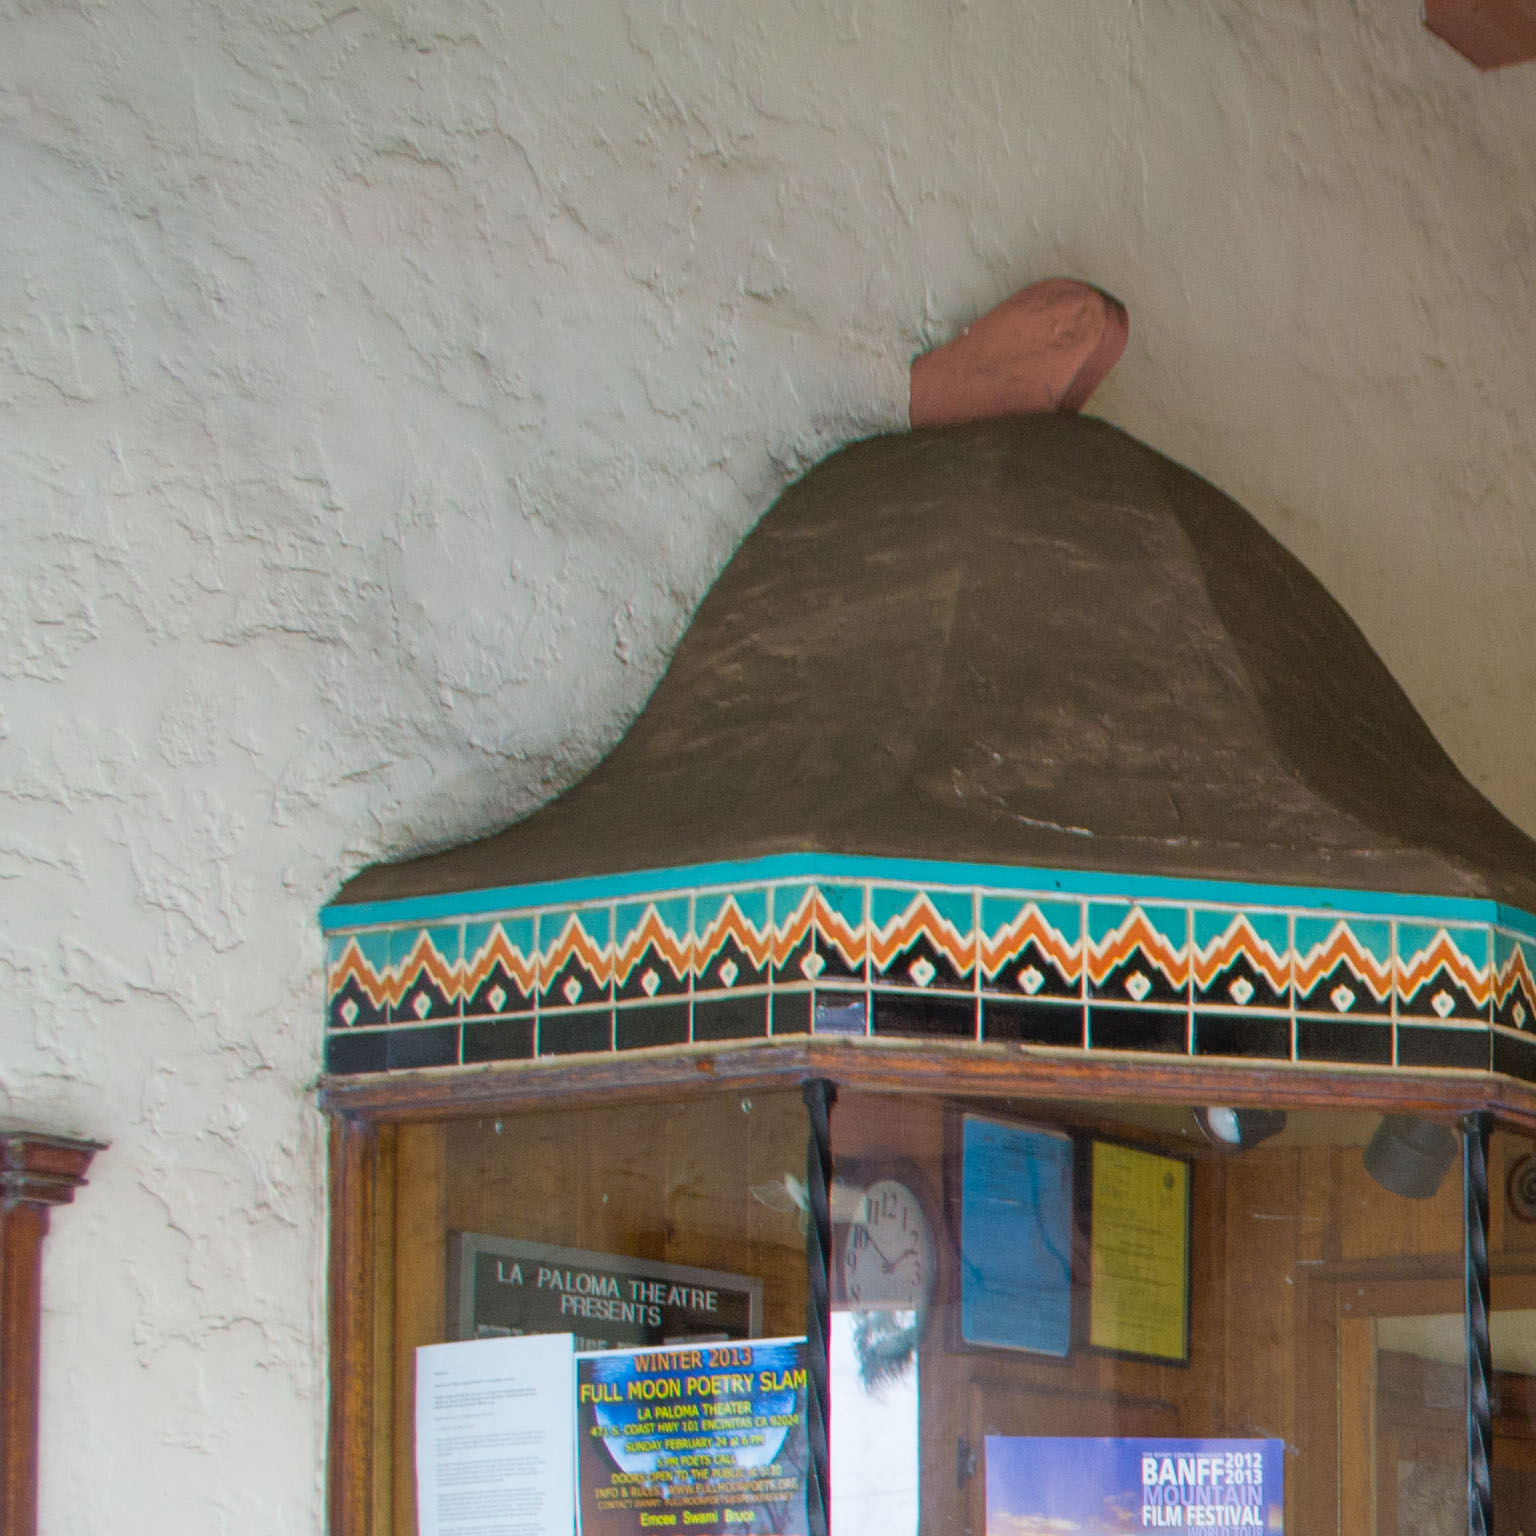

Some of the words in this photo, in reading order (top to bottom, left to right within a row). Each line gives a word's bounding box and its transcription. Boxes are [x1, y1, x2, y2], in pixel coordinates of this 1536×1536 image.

[497, 1261, 524, 1285] LA
[537, 1266, 621, 1298] PALOMA
[628, 1279, 719, 1312] THEATRE
[560, 1294, 662, 1327] PRESENTS
[633, 1350, 703, 1372] WINTER
[707, 1346, 753, 1368] 2013
[579, 1383, 623, 1403] FULL
[628, 1378, 682, 1400] MOON
[687, 1373, 755, 1397] POETRY
[759, 1369, 808, 1391] SLAM
[637, 1407, 652, 1421] LA
[655, 1404, 700, 1419] PALOMA
[702, 1400, 752, 1417] THEATER
[623, 1422, 656, 1436] COAST
[657, 1421, 679, 1433] HWY
[682, 1420, 700, 1432] 101
[702, 1417, 753, 1431] ENCINITAS
[625, 1441, 662, 1453] SUNDAY
[664, 1437, 713, 1450] FEBRUARY
[1142, 1457, 1224, 1485] BANFF
[1224, 1452, 1262, 1469] 2012
[1224, 1469, 1263, 1485] 2013
[1142, 1484, 1264, 1506] MOUNTAIN
[640, 1511, 677, 1527] Emcee
[682, 1510, 719, 1526] Swami
[724, 1508, 756, 1523] Bruce
[1142, 1505, 1183, 1527] FILM
[1186, 1504, 1264, 1527] FESTIVAL
